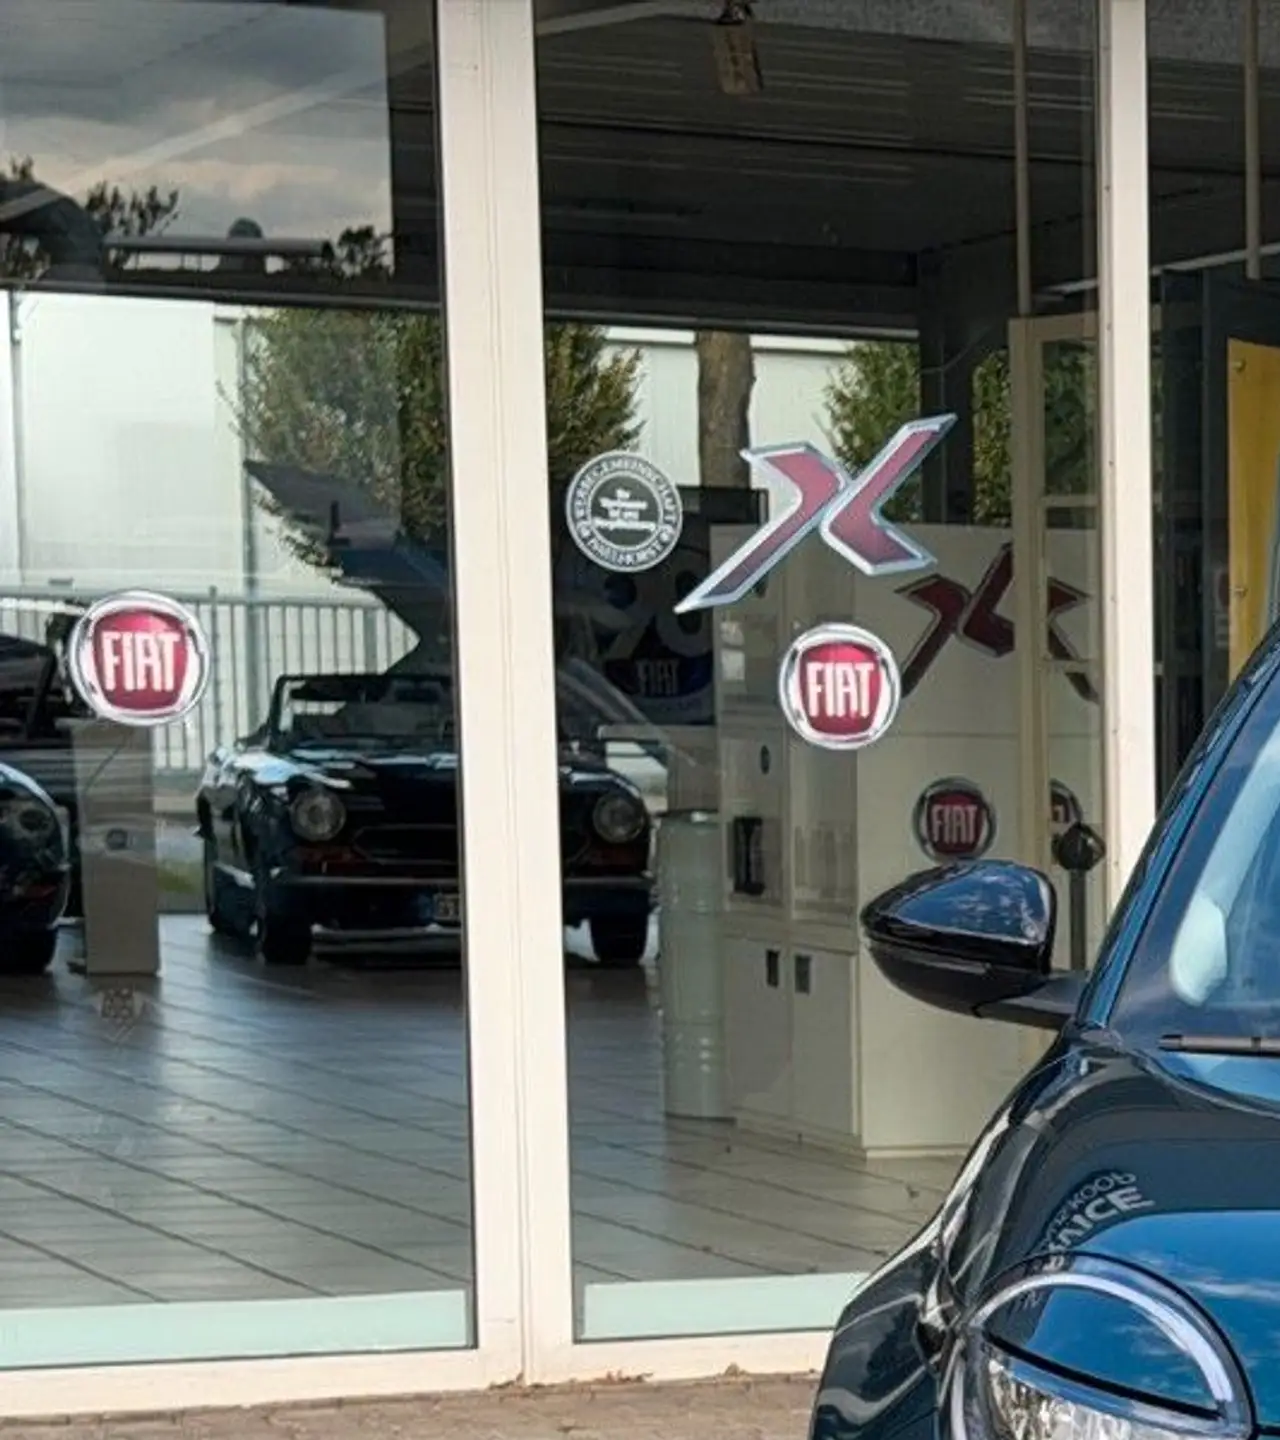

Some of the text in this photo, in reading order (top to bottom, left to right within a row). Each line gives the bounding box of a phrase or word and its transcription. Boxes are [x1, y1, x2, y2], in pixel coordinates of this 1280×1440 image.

[102, 630, 181, 692] FIAT
[806, 661, 875, 718] FIAT
[932, 802, 980, 845] FIAT
